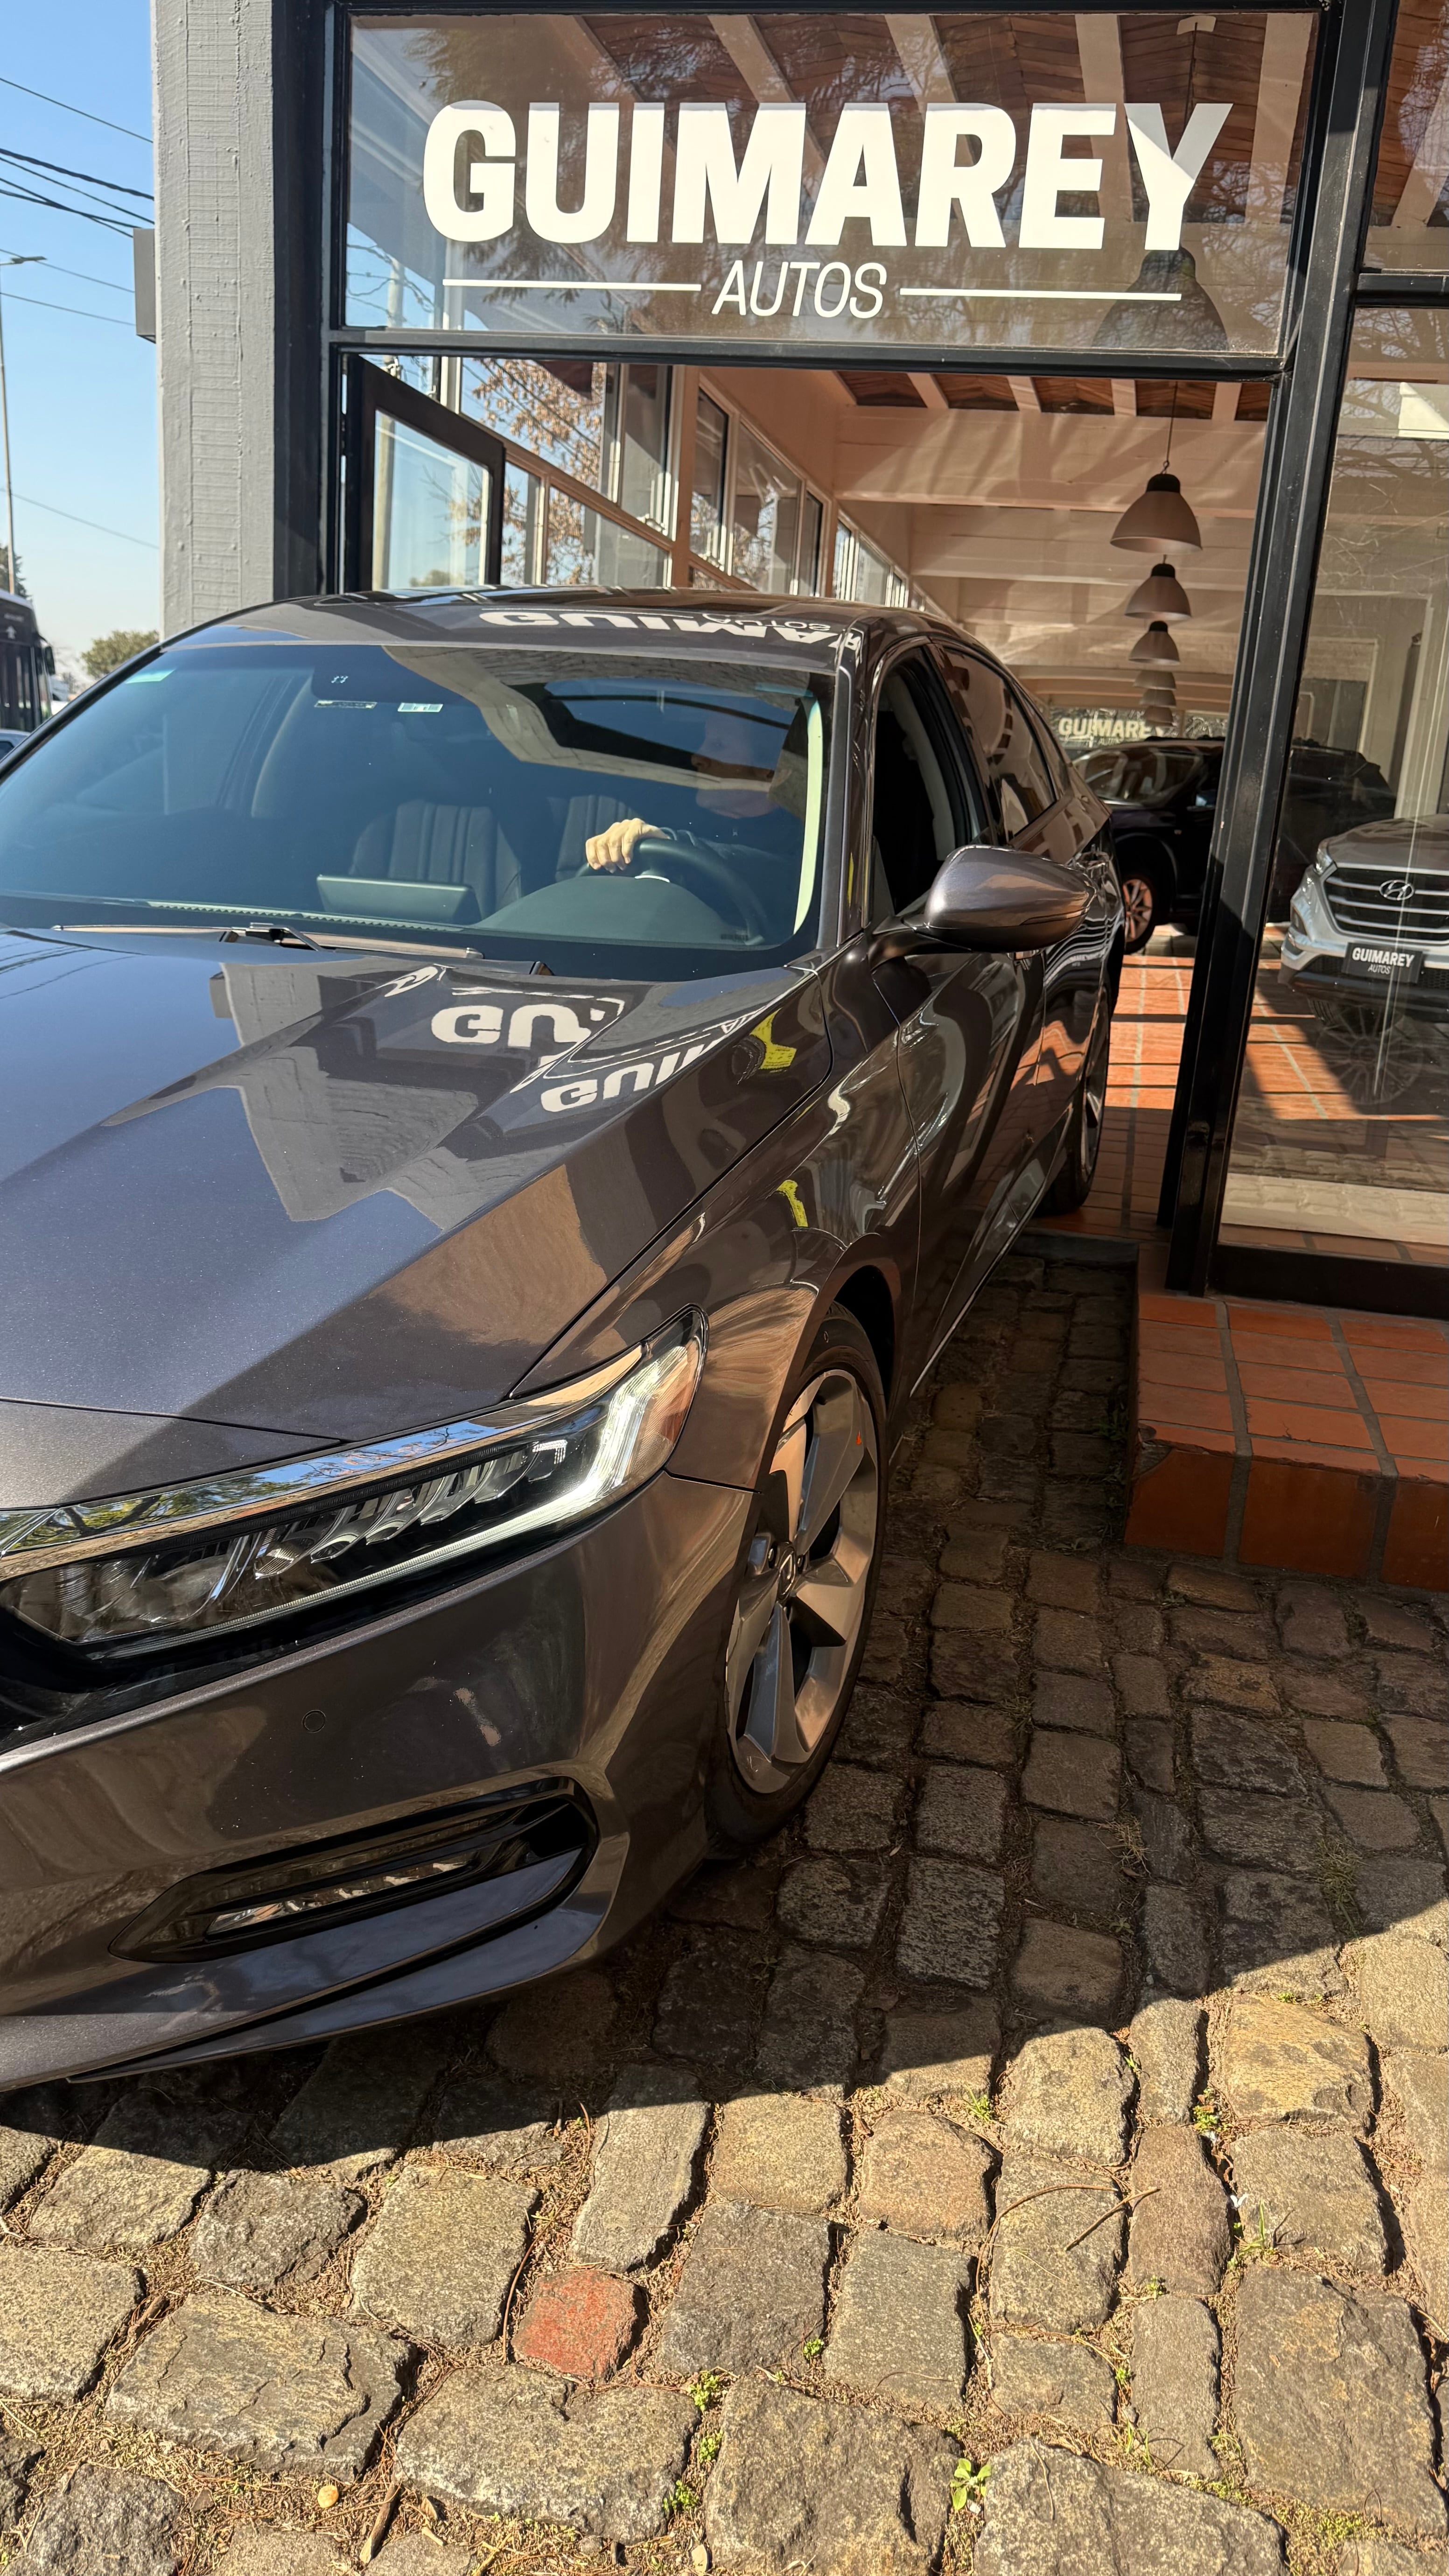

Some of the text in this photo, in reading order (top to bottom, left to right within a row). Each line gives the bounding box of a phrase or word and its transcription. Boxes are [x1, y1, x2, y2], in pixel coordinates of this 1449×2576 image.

[422, 101, 1232, 251] GUIMAREY
[711, 260, 887, 318] AUTOS
[1352, 947, 1415, 967] GUIMAREY
[1368, 964, 1391, 975] AUTOS
